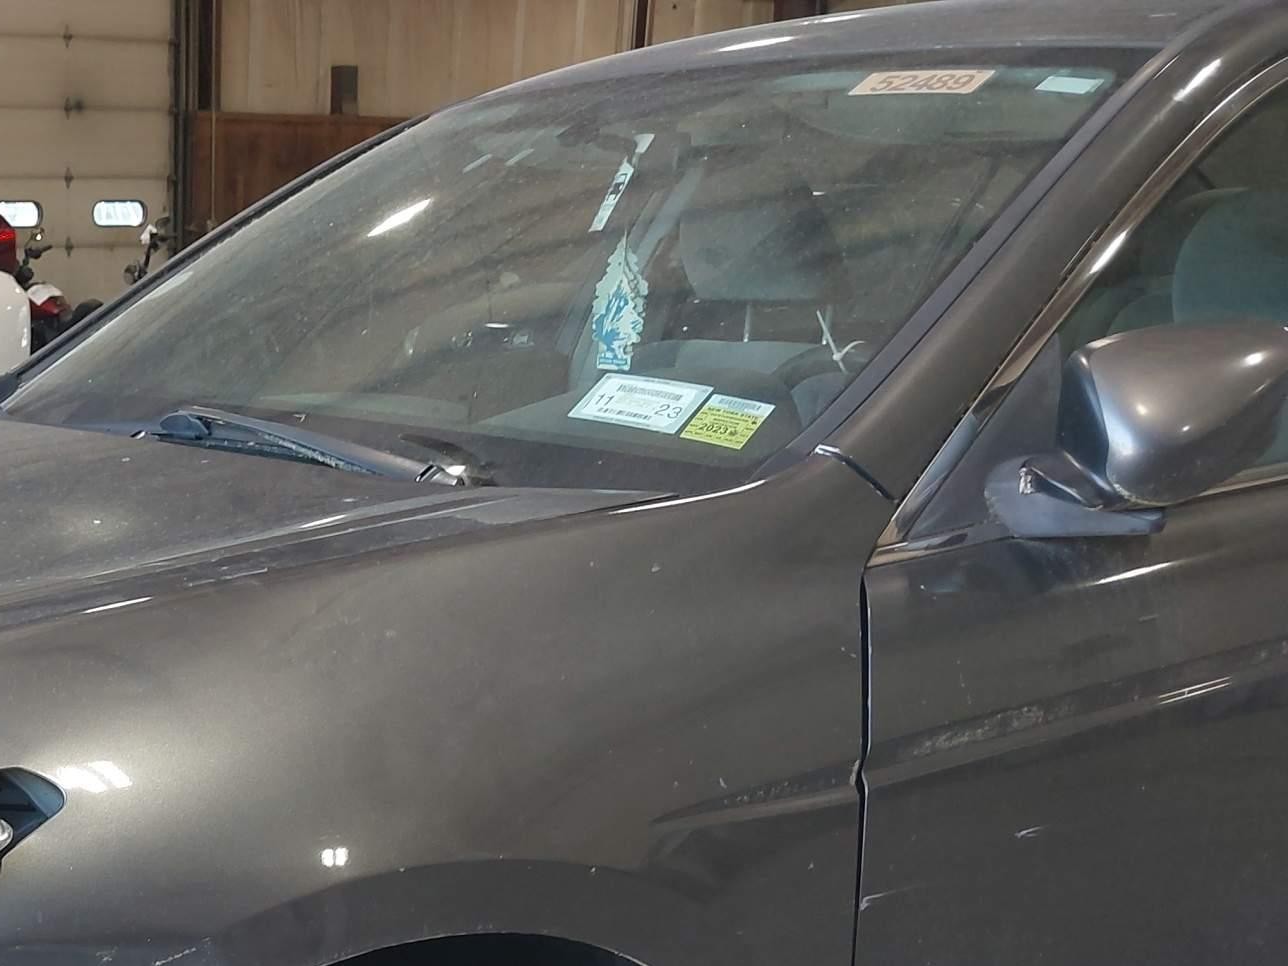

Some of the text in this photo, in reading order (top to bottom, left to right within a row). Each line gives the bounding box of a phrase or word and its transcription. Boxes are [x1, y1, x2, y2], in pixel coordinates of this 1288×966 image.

[870, 74, 975, 91] 52489
[596, 393, 615, 406] 11
[653, 403, 683, 419] 23
[698, 422, 729, 435] 2023
